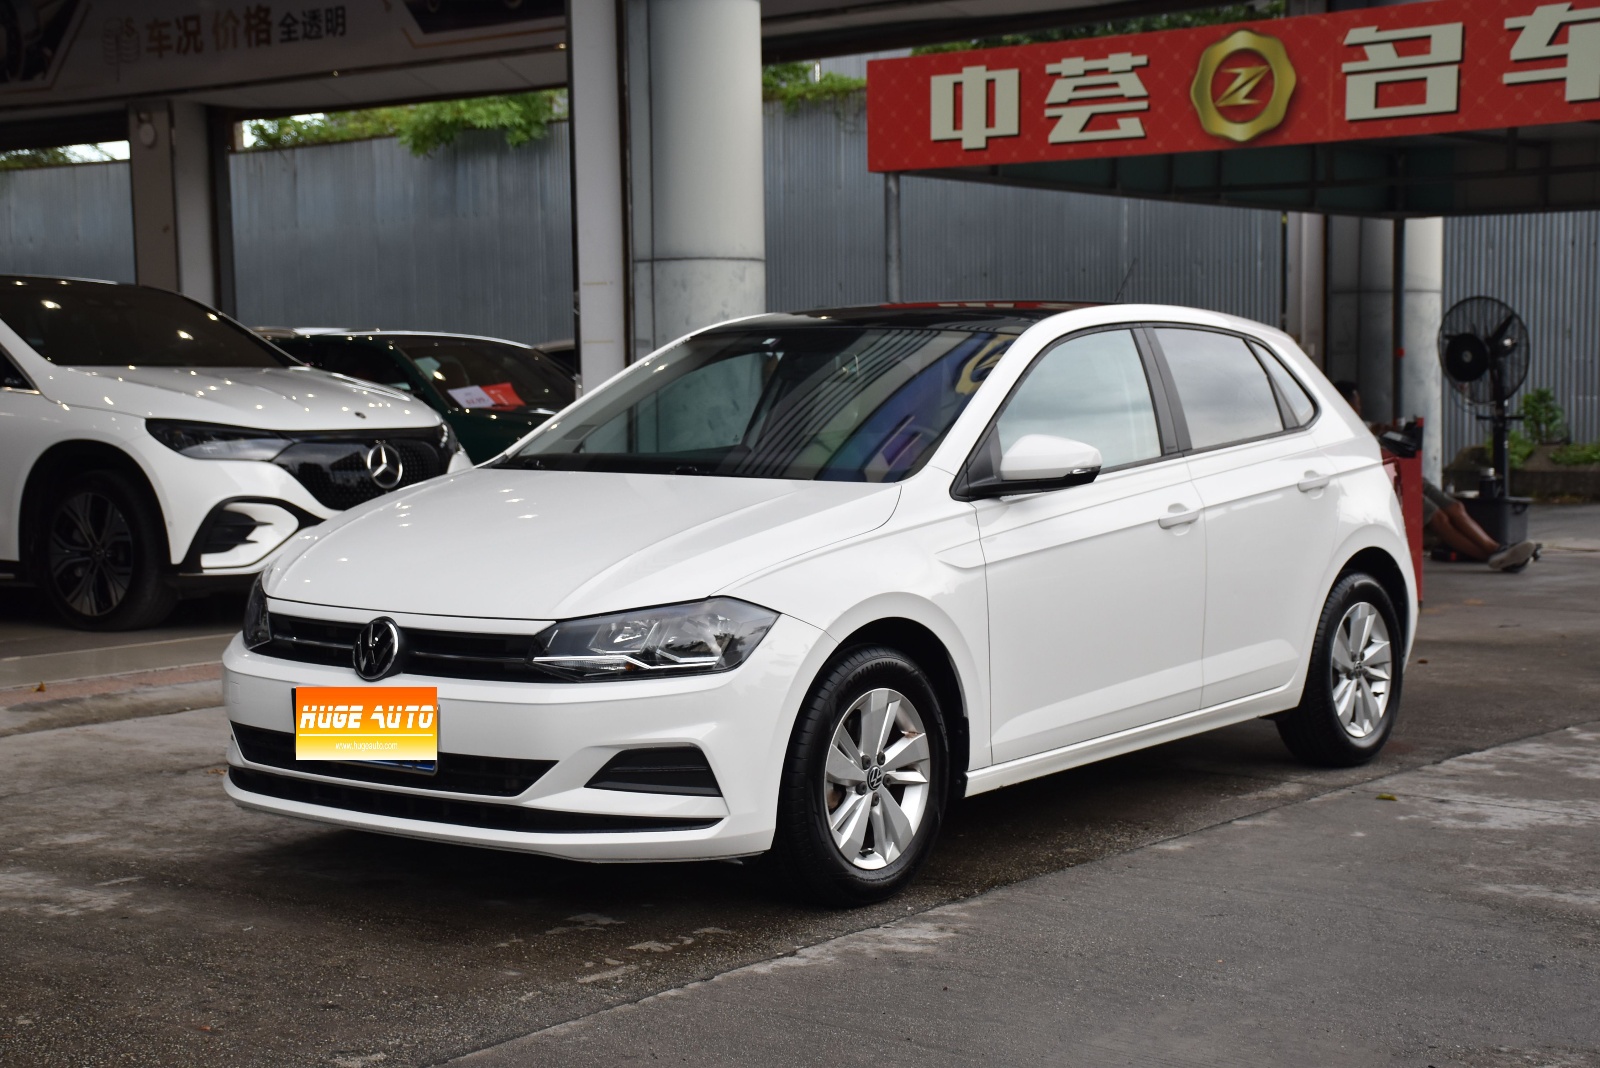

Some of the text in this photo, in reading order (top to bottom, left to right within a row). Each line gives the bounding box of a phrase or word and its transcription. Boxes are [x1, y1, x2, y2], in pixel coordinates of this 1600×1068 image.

[145, 4, 347, 59] 车况 价格 全透明
[930, 2, 1600, 150] 中荟 名车
